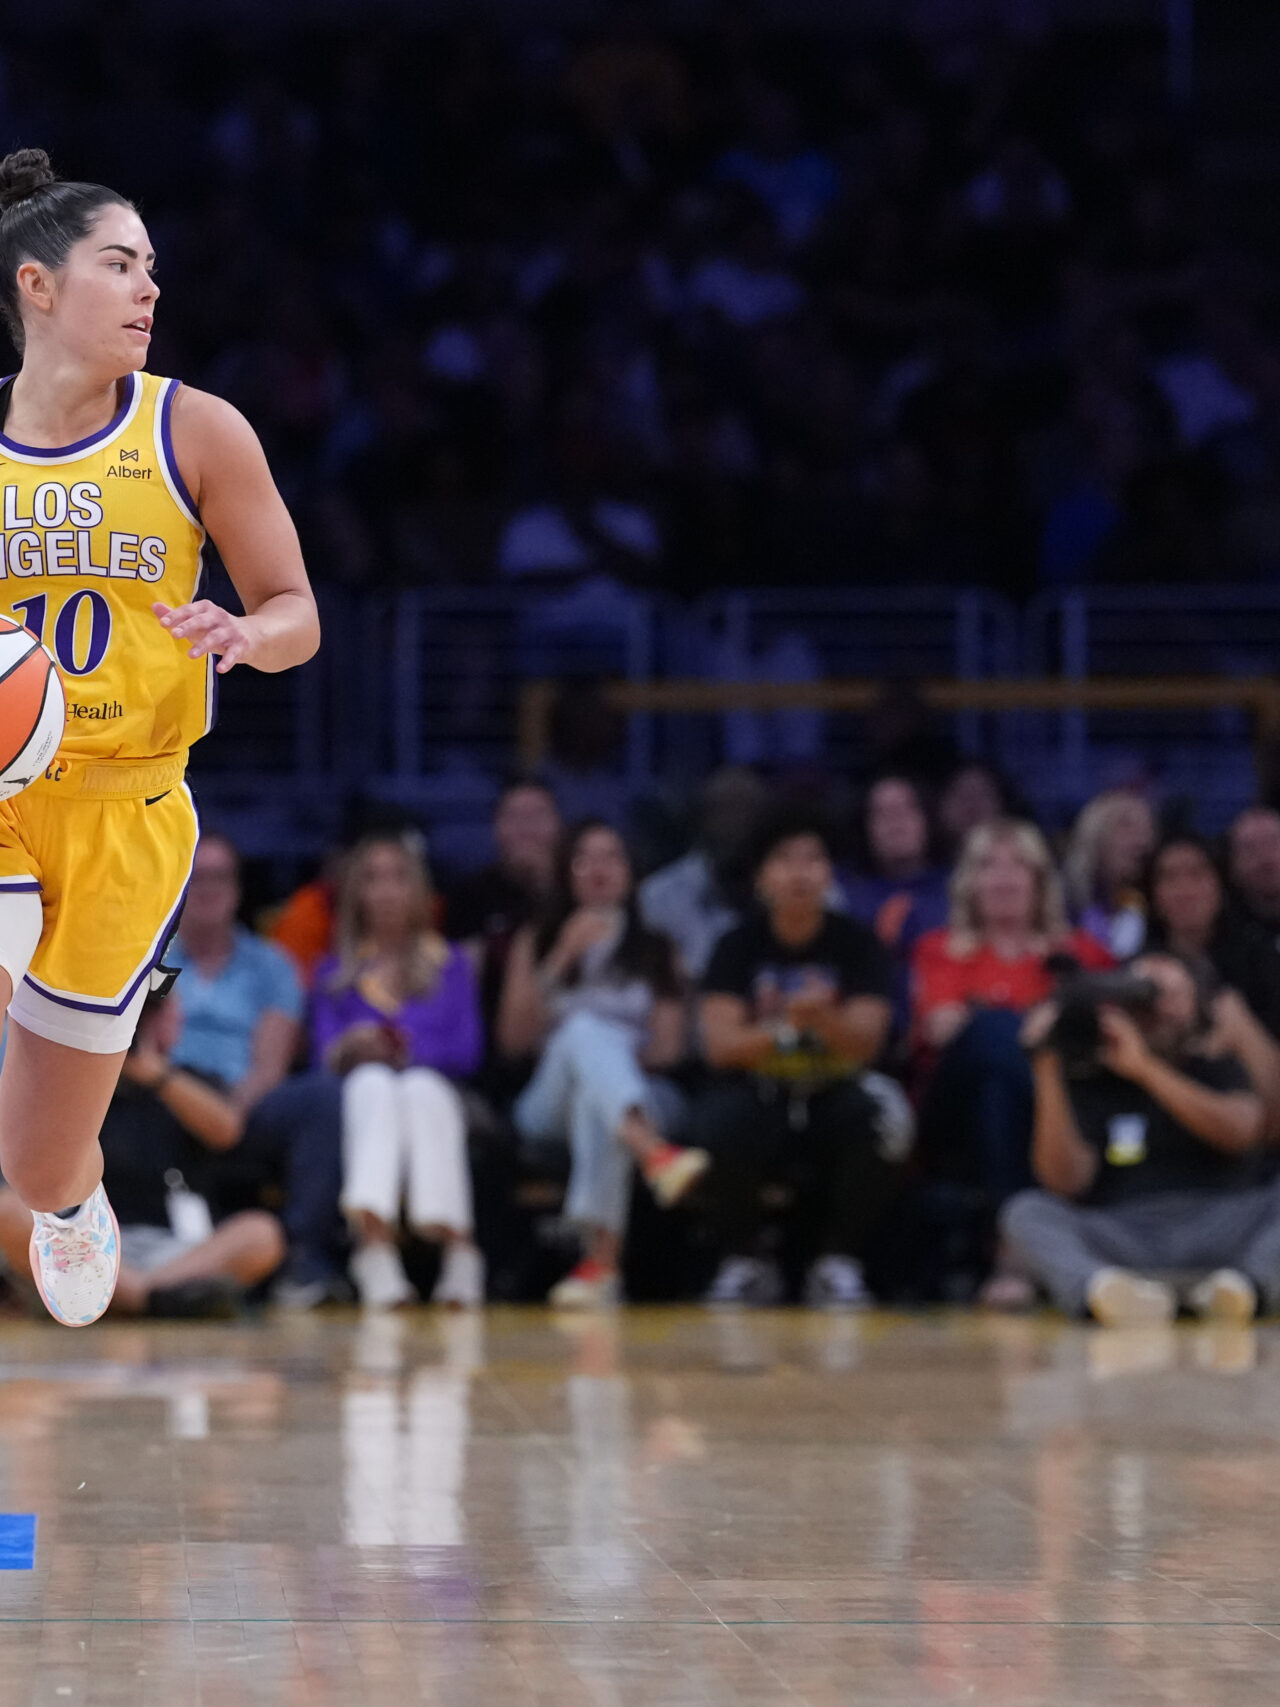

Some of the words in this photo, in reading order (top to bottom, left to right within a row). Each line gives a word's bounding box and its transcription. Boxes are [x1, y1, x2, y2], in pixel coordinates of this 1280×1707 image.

[106, 465, 152, 480] Albert
[4, 482, 103, 530] LOS
[11, 588, 113, 677] 10
